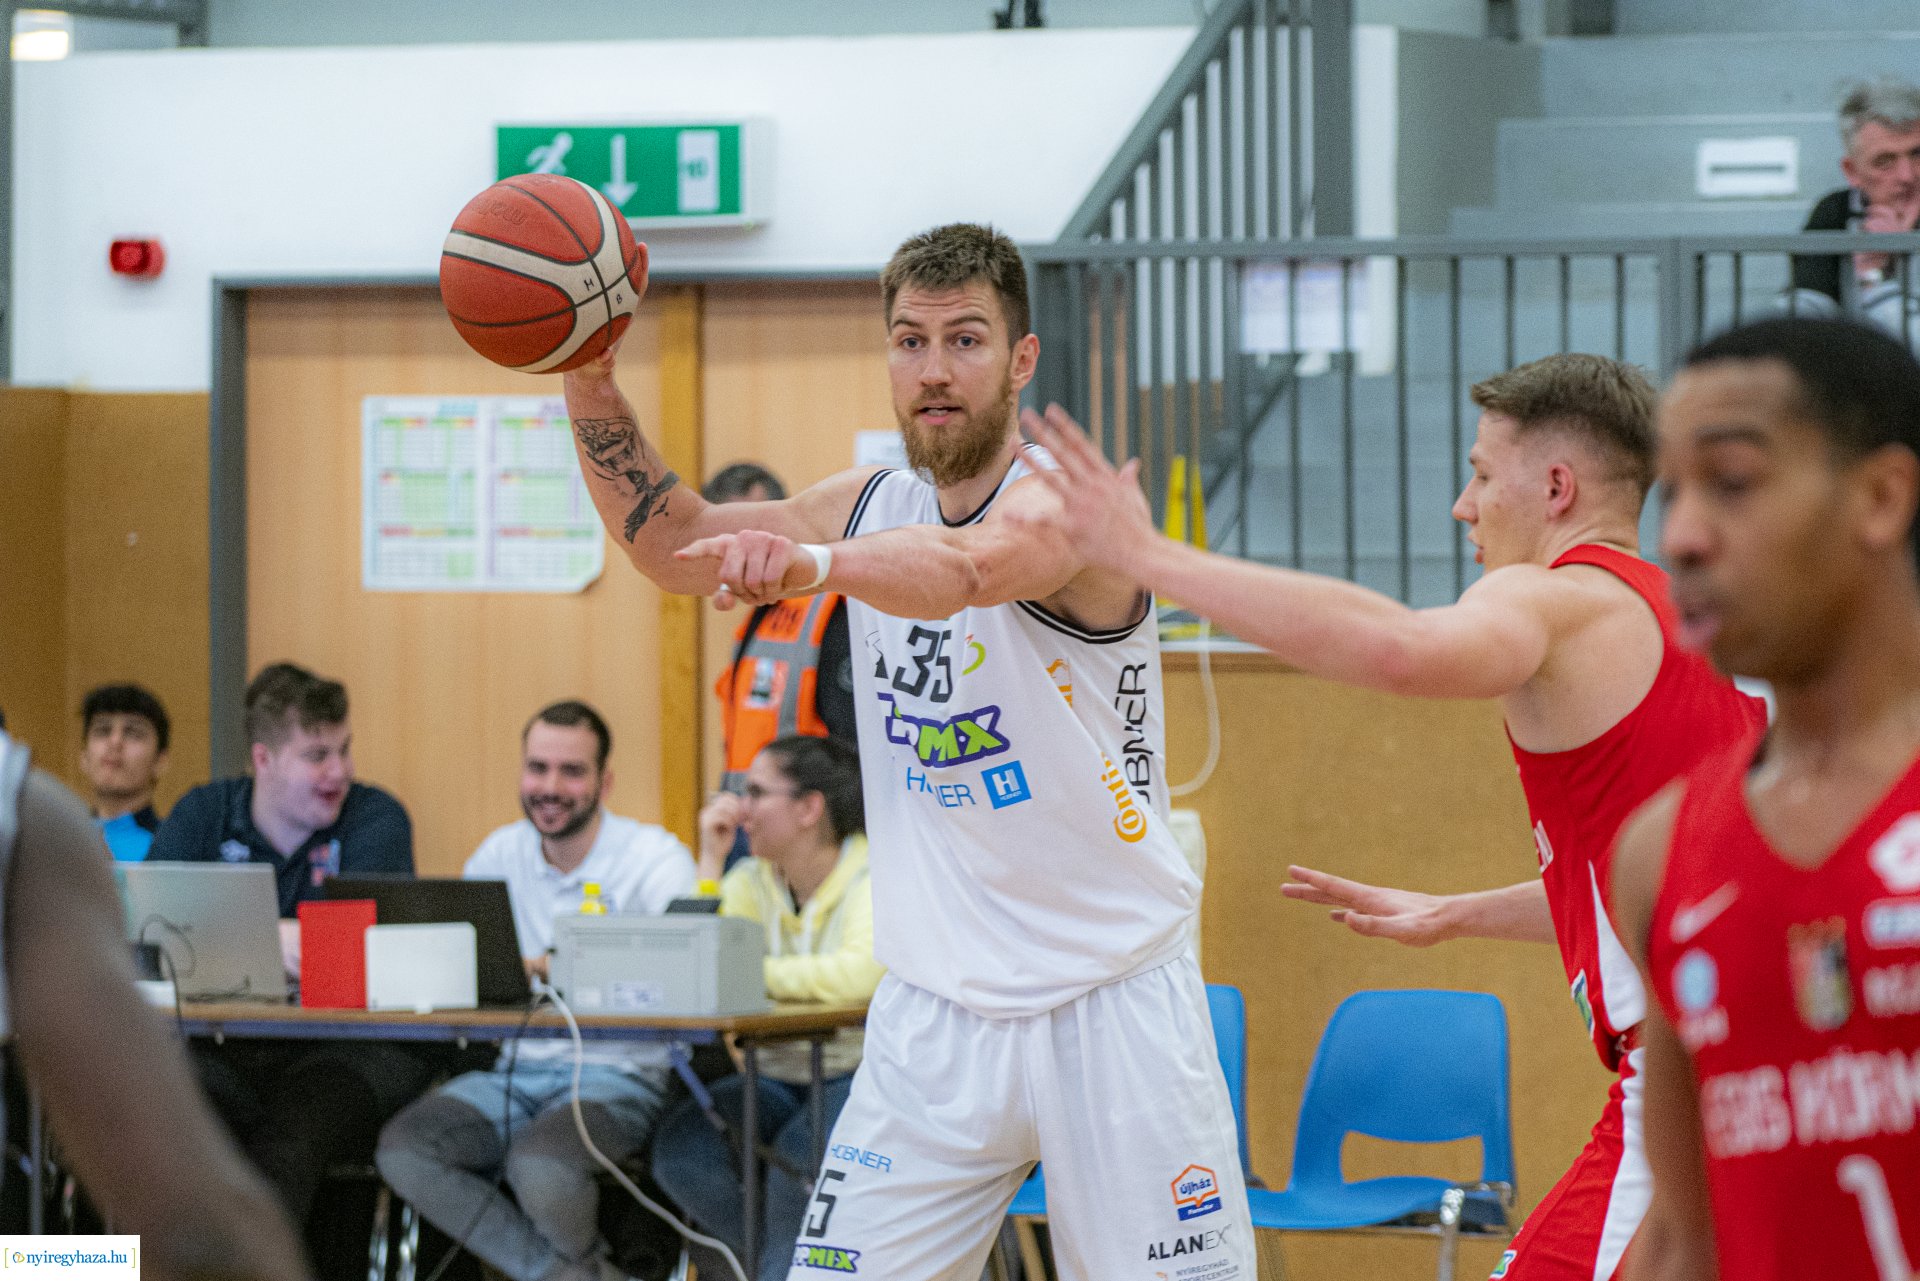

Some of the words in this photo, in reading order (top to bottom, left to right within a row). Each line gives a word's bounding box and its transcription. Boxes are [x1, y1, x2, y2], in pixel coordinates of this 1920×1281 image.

[892, 625, 953, 704] 35
[1114, 662, 1154, 804] BNER
[806, 1169, 847, 1238] 5
[800, 1244, 861, 1273] MIX
[1147, 1223, 1232, 1261] ALANEX
